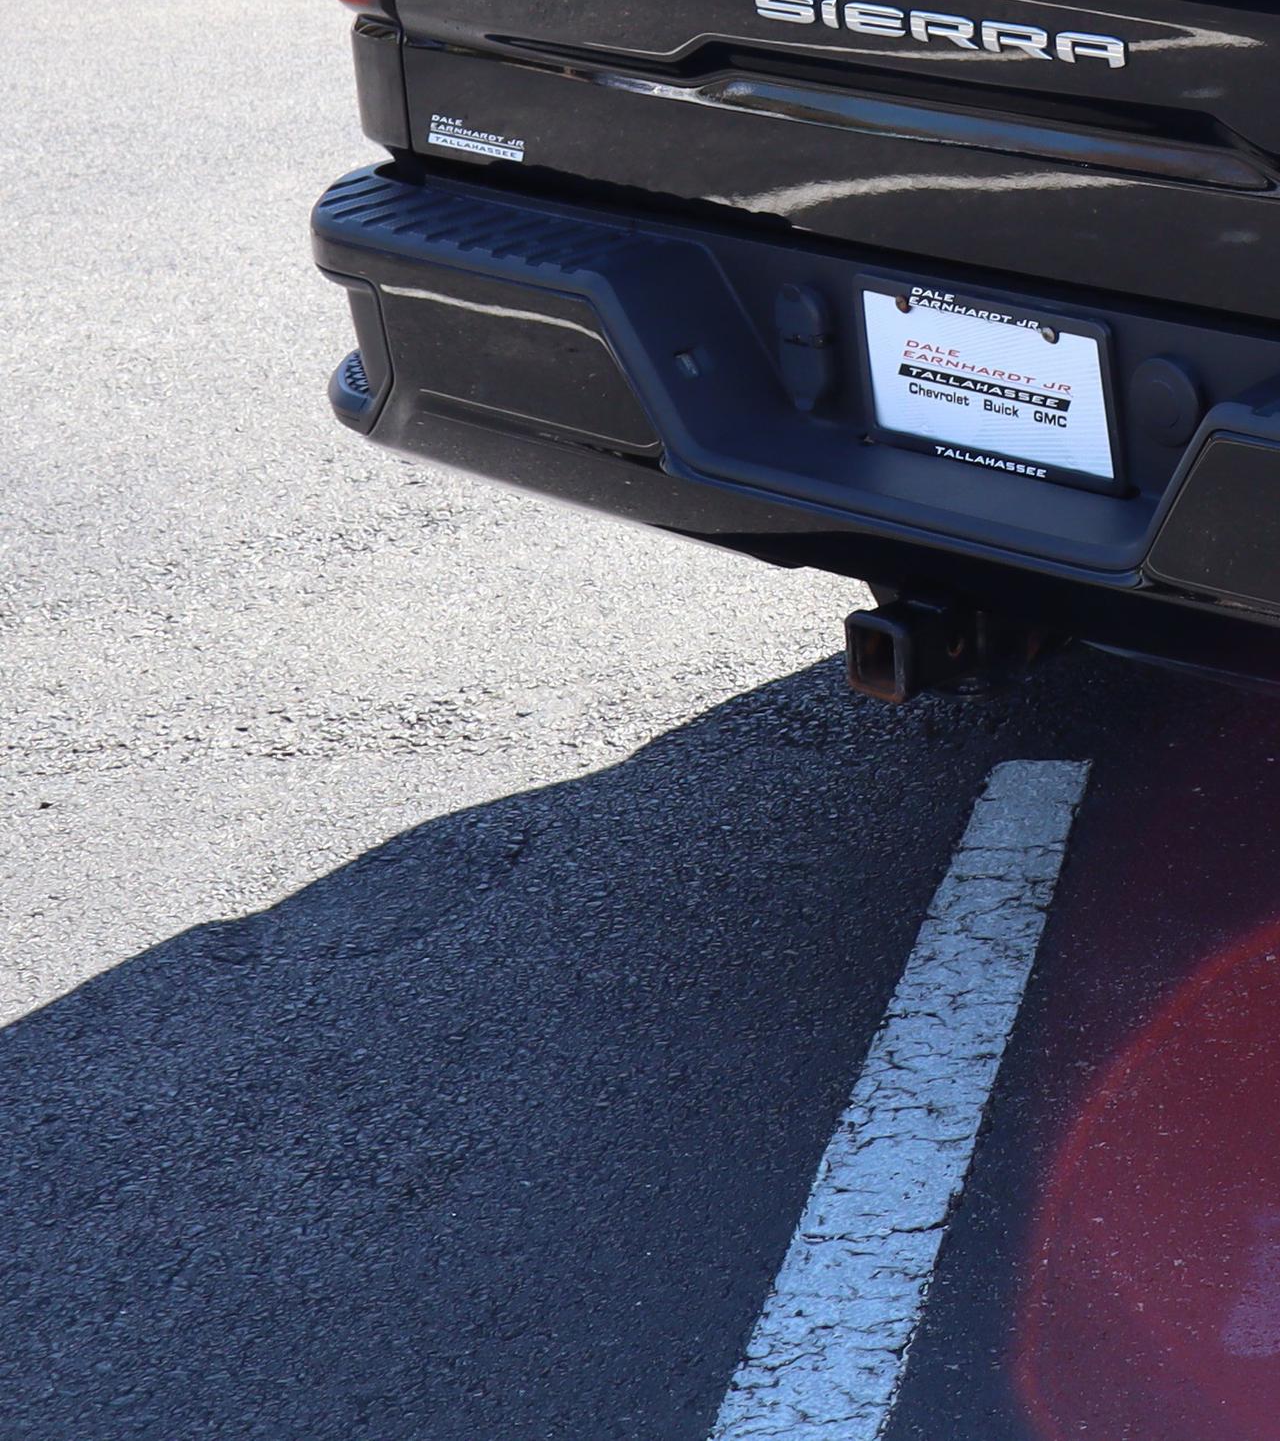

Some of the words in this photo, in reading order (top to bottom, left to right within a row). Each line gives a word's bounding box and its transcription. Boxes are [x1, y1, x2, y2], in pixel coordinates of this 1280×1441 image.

[431, 114, 463, 126] DALE
[430, 122, 505, 143] EARNHARDT
[507, 138, 524, 147] JR
[434, 137, 517, 158] TALLAHASSEE
[911, 286, 955, 303] DALE
[909, 296, 1012, 323] EARNHARDT
[906, 340, 960, 357] DALE
[904, 351, 1036, 384] EARNHARDT
[1044, 382, 1072, 393] JR
[908, 367, 1061, 408] TALLAHASSEE
[909, 383, 970, 406] Chevrolet
[983, 398, 1020, 419] Buick
[1033, 410, 1068, 429] GMC
[935, 446, 1047, 478] TALLAHASSEE
